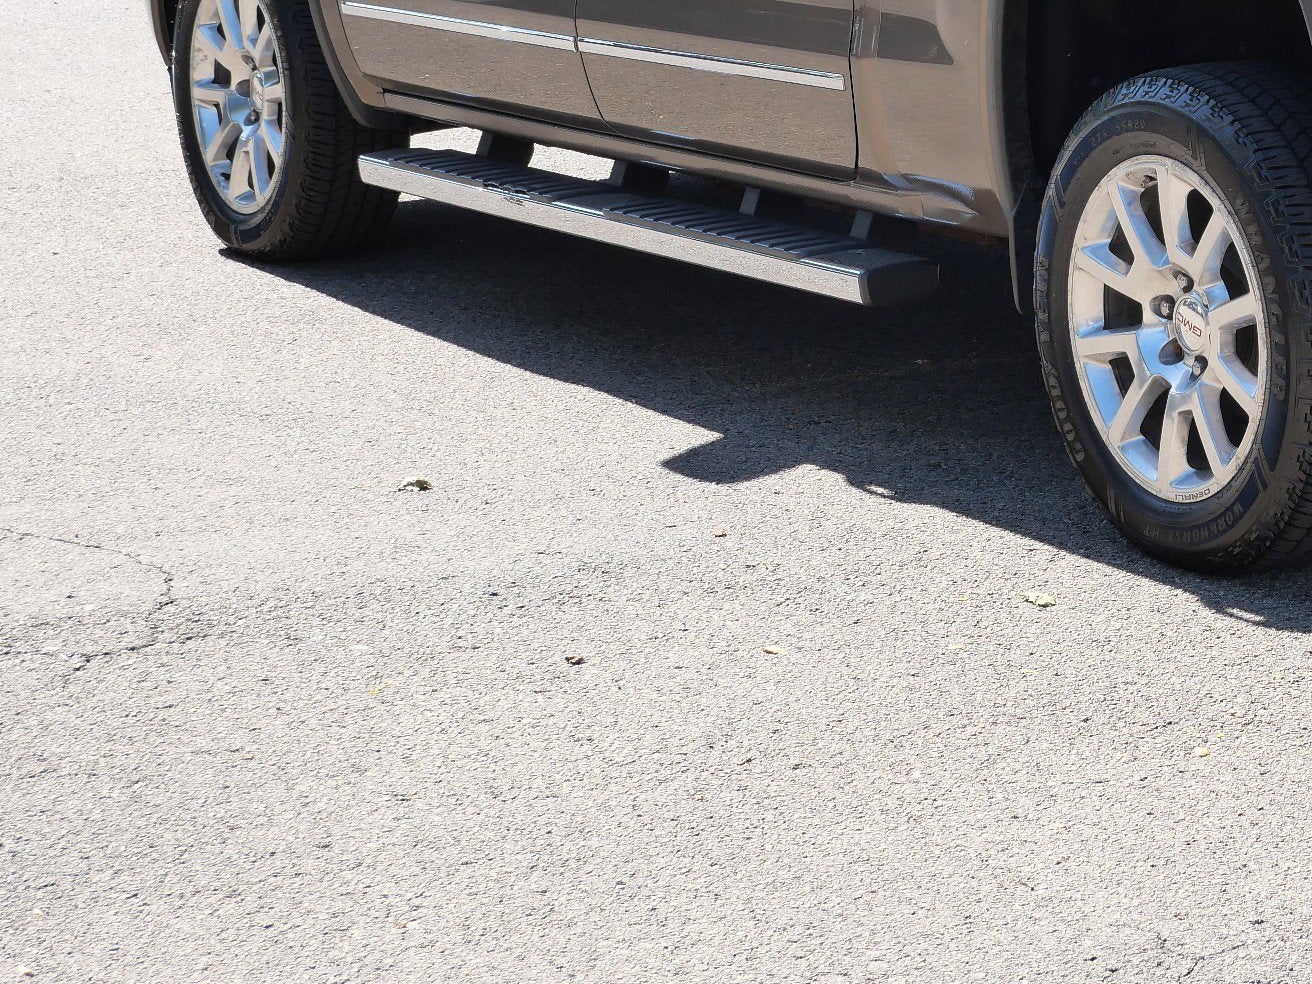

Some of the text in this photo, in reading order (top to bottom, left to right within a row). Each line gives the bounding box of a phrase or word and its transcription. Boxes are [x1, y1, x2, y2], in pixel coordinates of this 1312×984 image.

[1235, 194, 1287, 400] WRANGLER
[1177, 312, 1202, 337] GMC
[1175, 488, 1211, 500] DENALI
